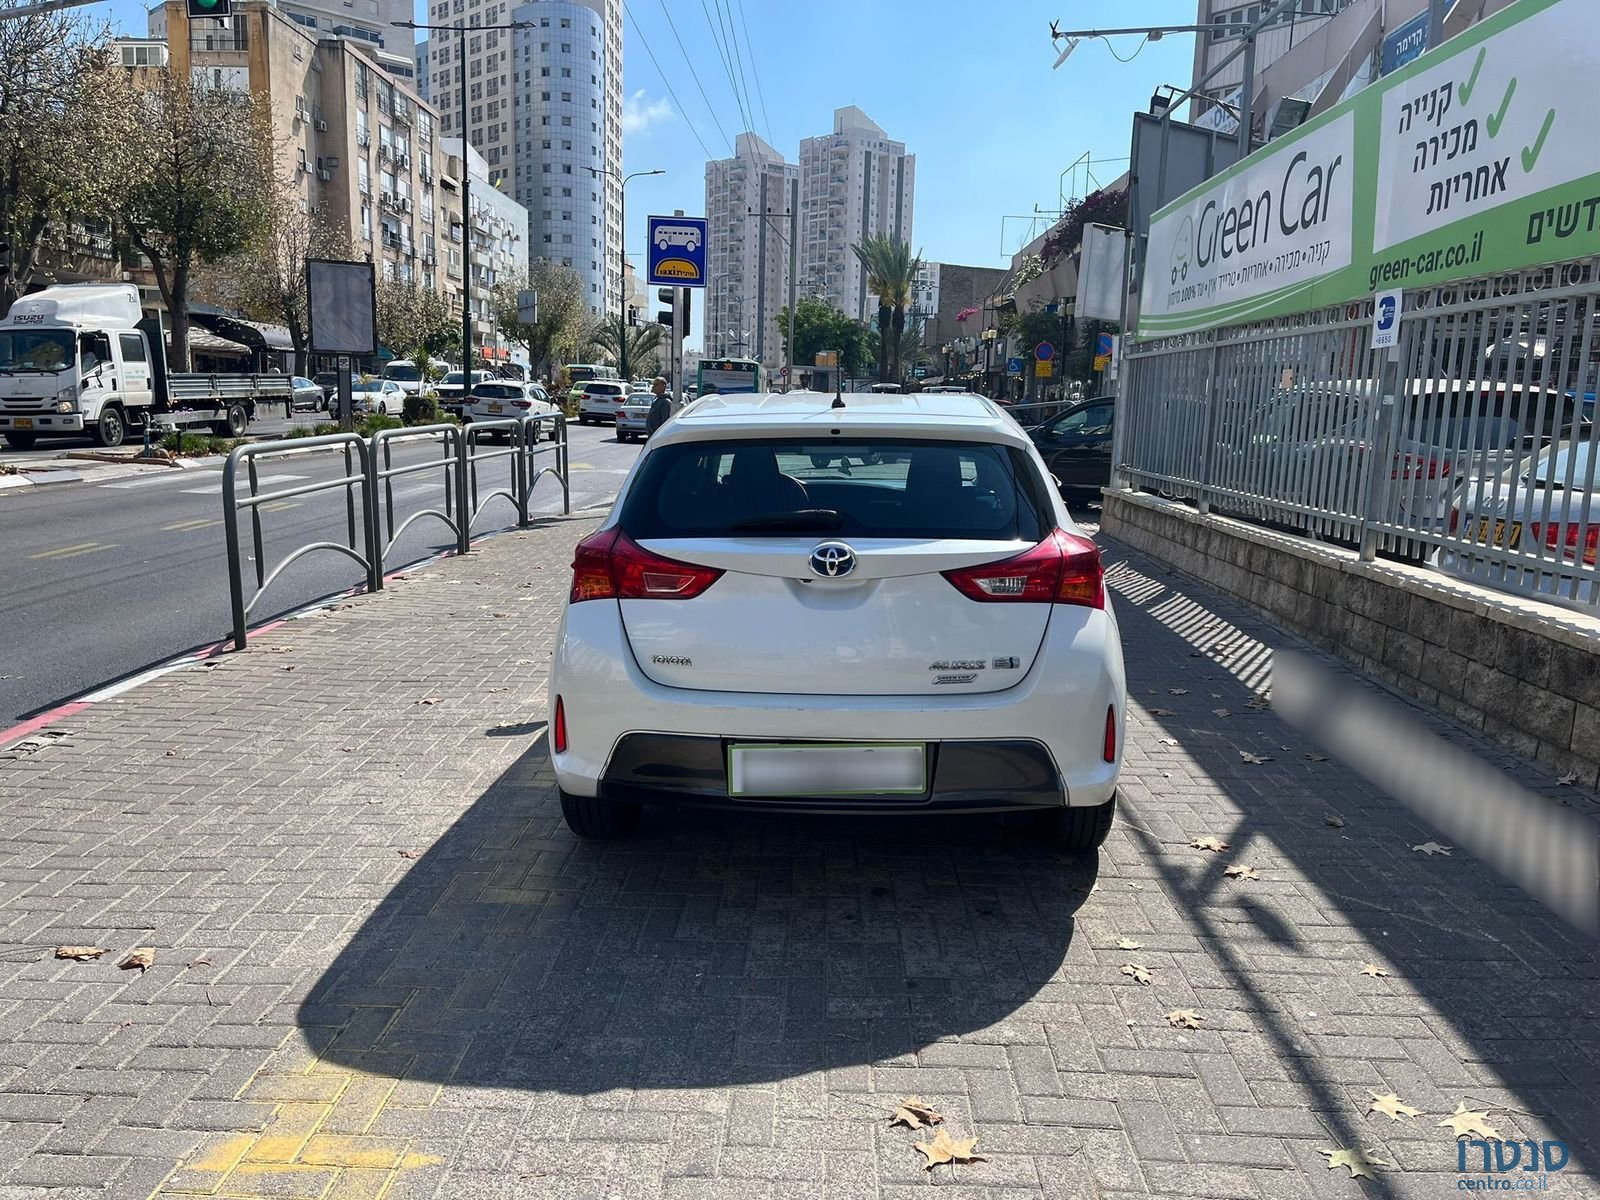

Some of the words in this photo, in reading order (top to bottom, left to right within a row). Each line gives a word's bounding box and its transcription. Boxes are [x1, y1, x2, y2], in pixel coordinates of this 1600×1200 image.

[1398, 80, 1454, 135] קנייה
[1412, 118, 1478, 173] מכירה
[1426, 156, 1511, 215] אחריות
[1197, 189, 1271, 268] Green
[1279, 150, 1342, 236] Car
[1526, 195, 1600, 246] דשים
[659, 265, 676, 276] taxi
[1240, 260, 1268, 283] אחריות
[1273, 249, 1301, 273] מכירה
[1307, 240, 1331, 267] קניה
[1369, 230, 1484, 291] green-car.co.il
[650, 655, 693, 667] TOYOTA
[928, 659, 987, 671] AURIS
